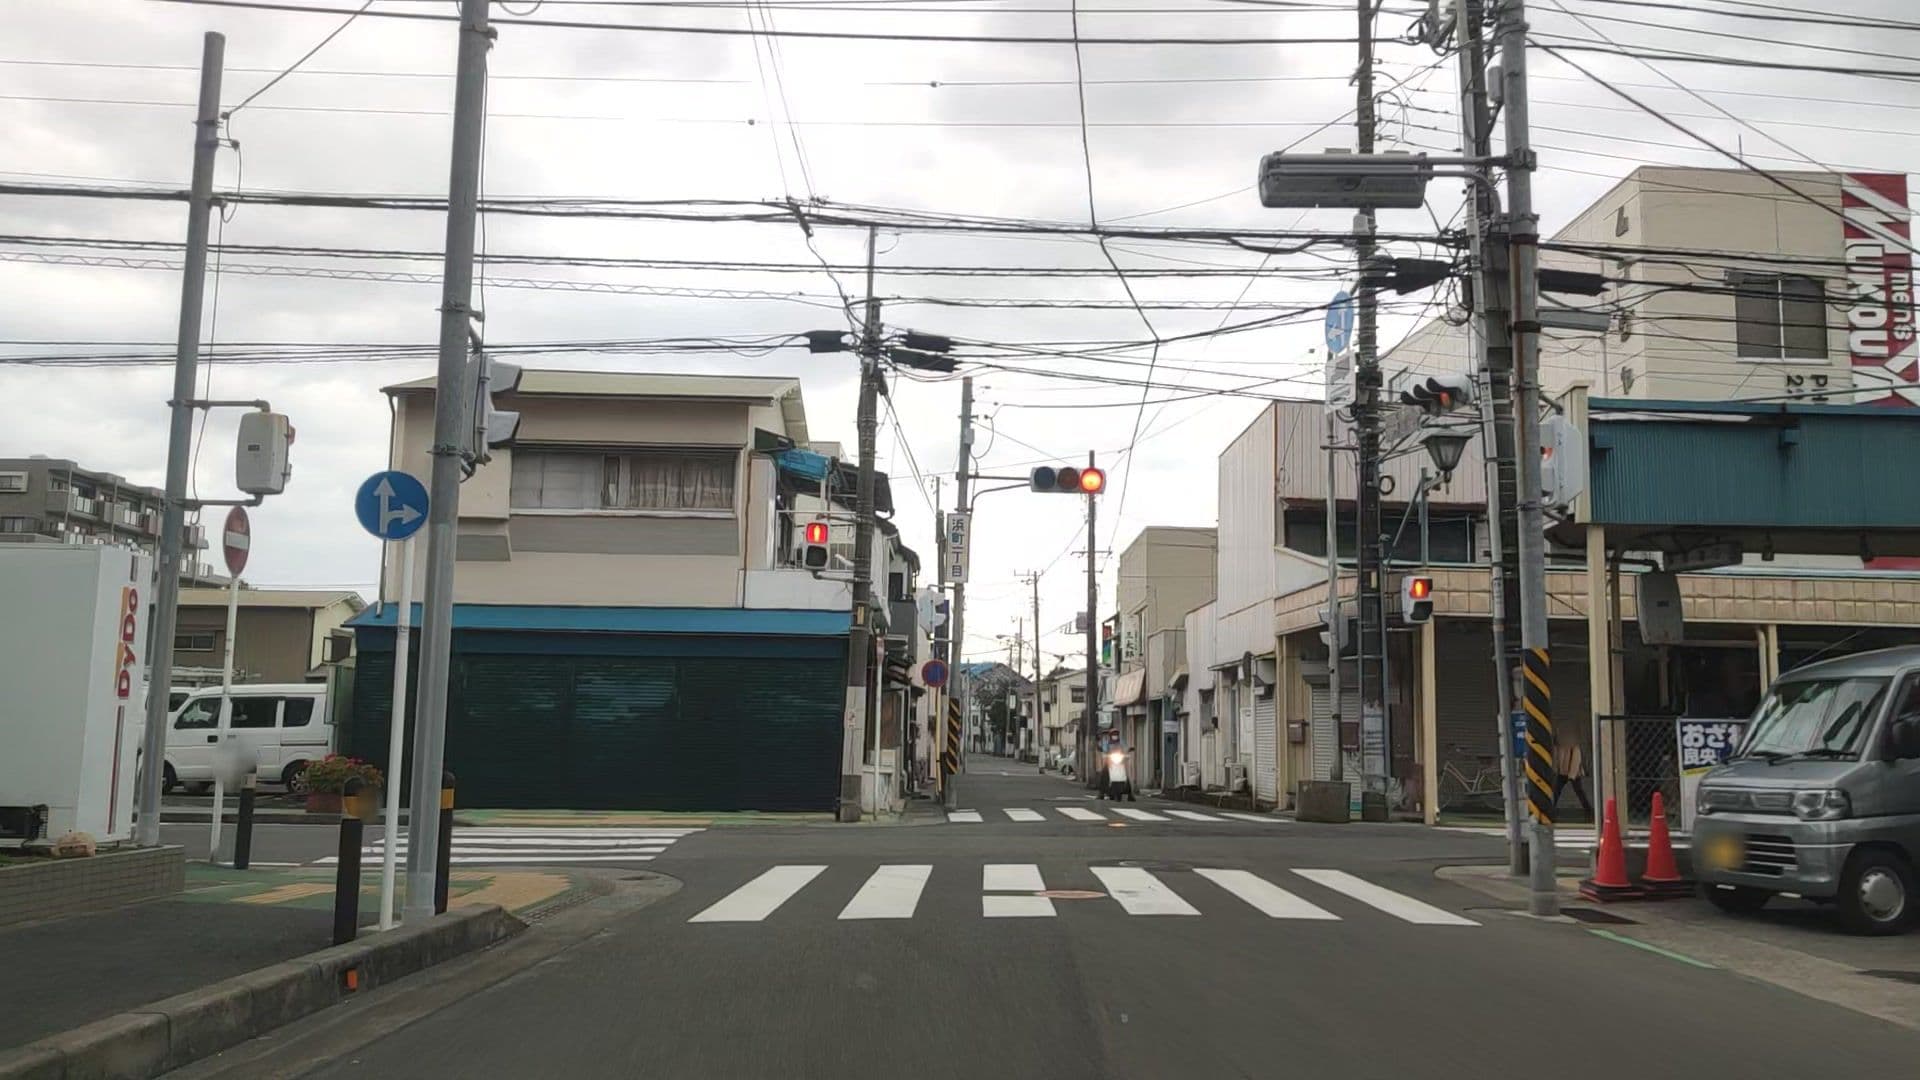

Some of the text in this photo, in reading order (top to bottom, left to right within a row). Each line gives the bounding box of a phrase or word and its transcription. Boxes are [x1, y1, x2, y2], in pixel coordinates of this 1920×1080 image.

[951, 517, 965, 578] 浜町一丁目
